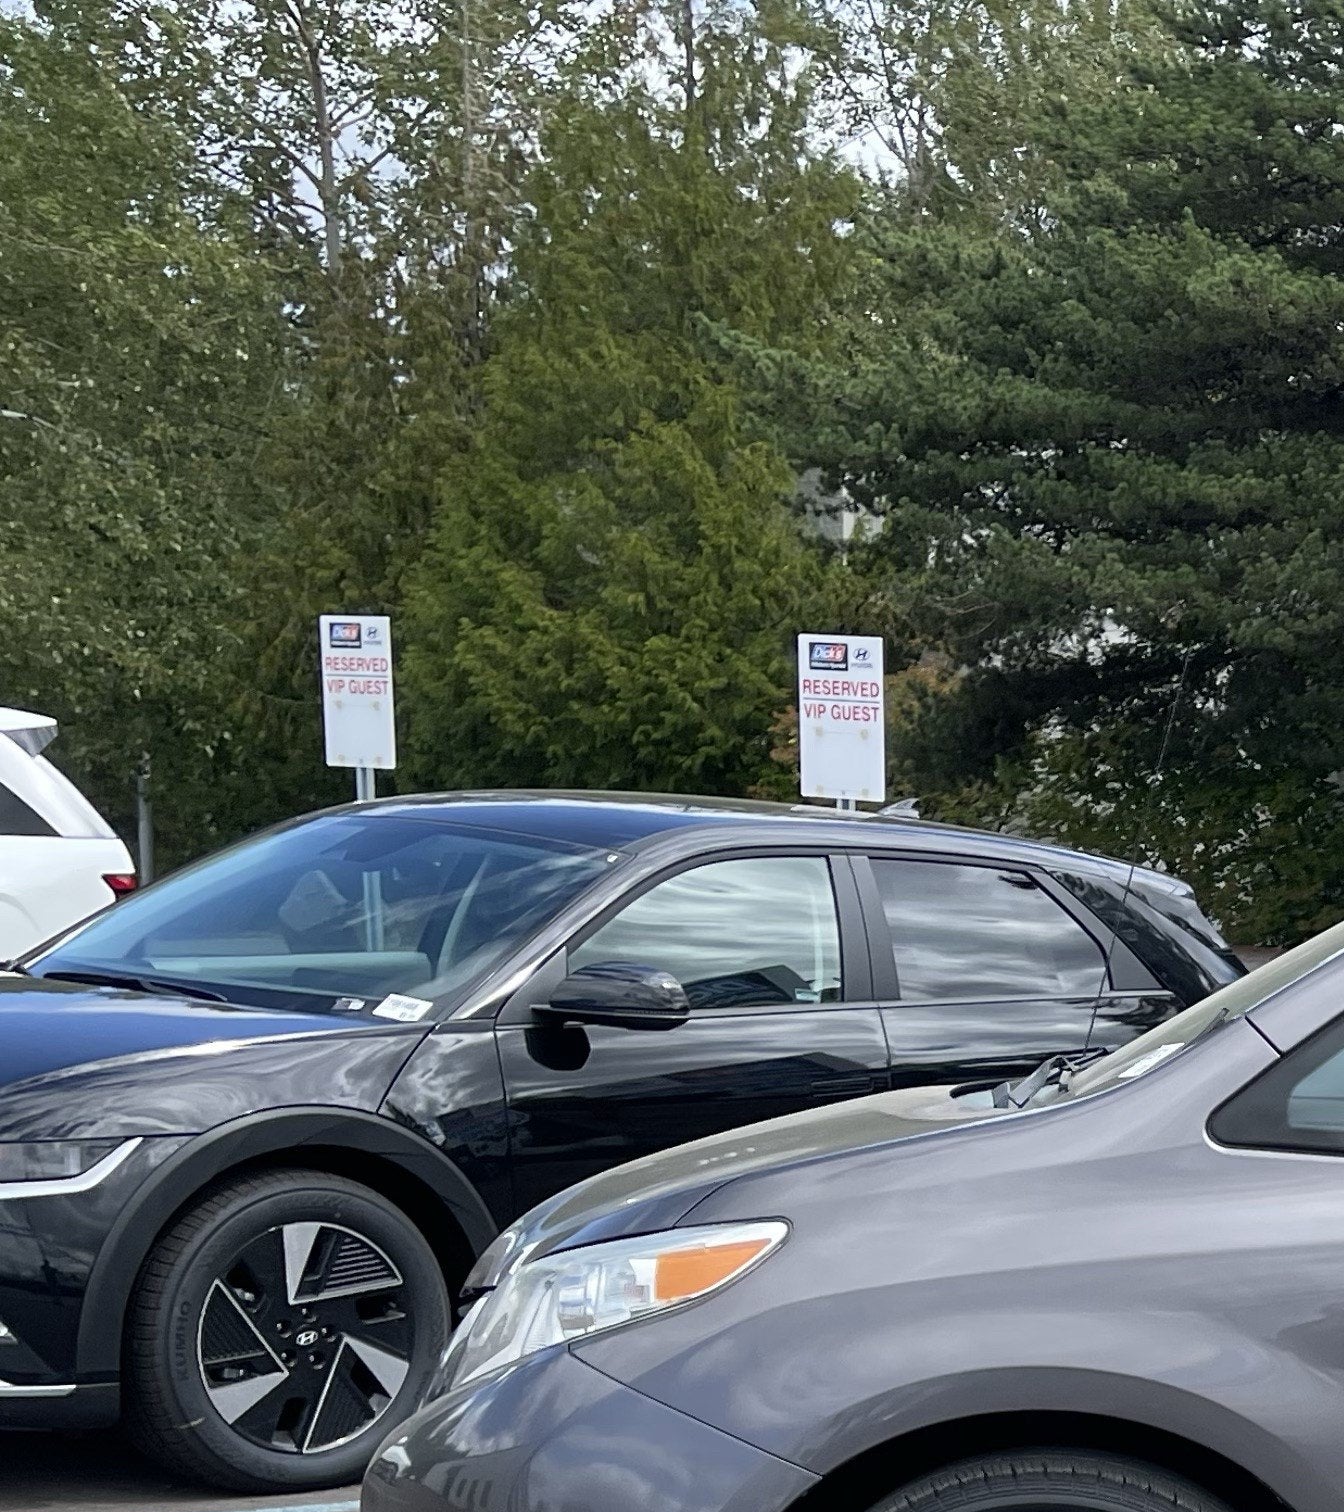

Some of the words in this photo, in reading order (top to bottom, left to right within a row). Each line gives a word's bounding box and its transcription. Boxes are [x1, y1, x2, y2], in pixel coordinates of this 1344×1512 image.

[325, 656, 388, 672] RESERVED
[326, 679, 345, 694] VIP
[349, 679, 388, 695] GUEST
[802, 679, 880, 698] RESERVED
[804, 703, 826, 719] VIP
[831, 704, 880, 722] GUEST
